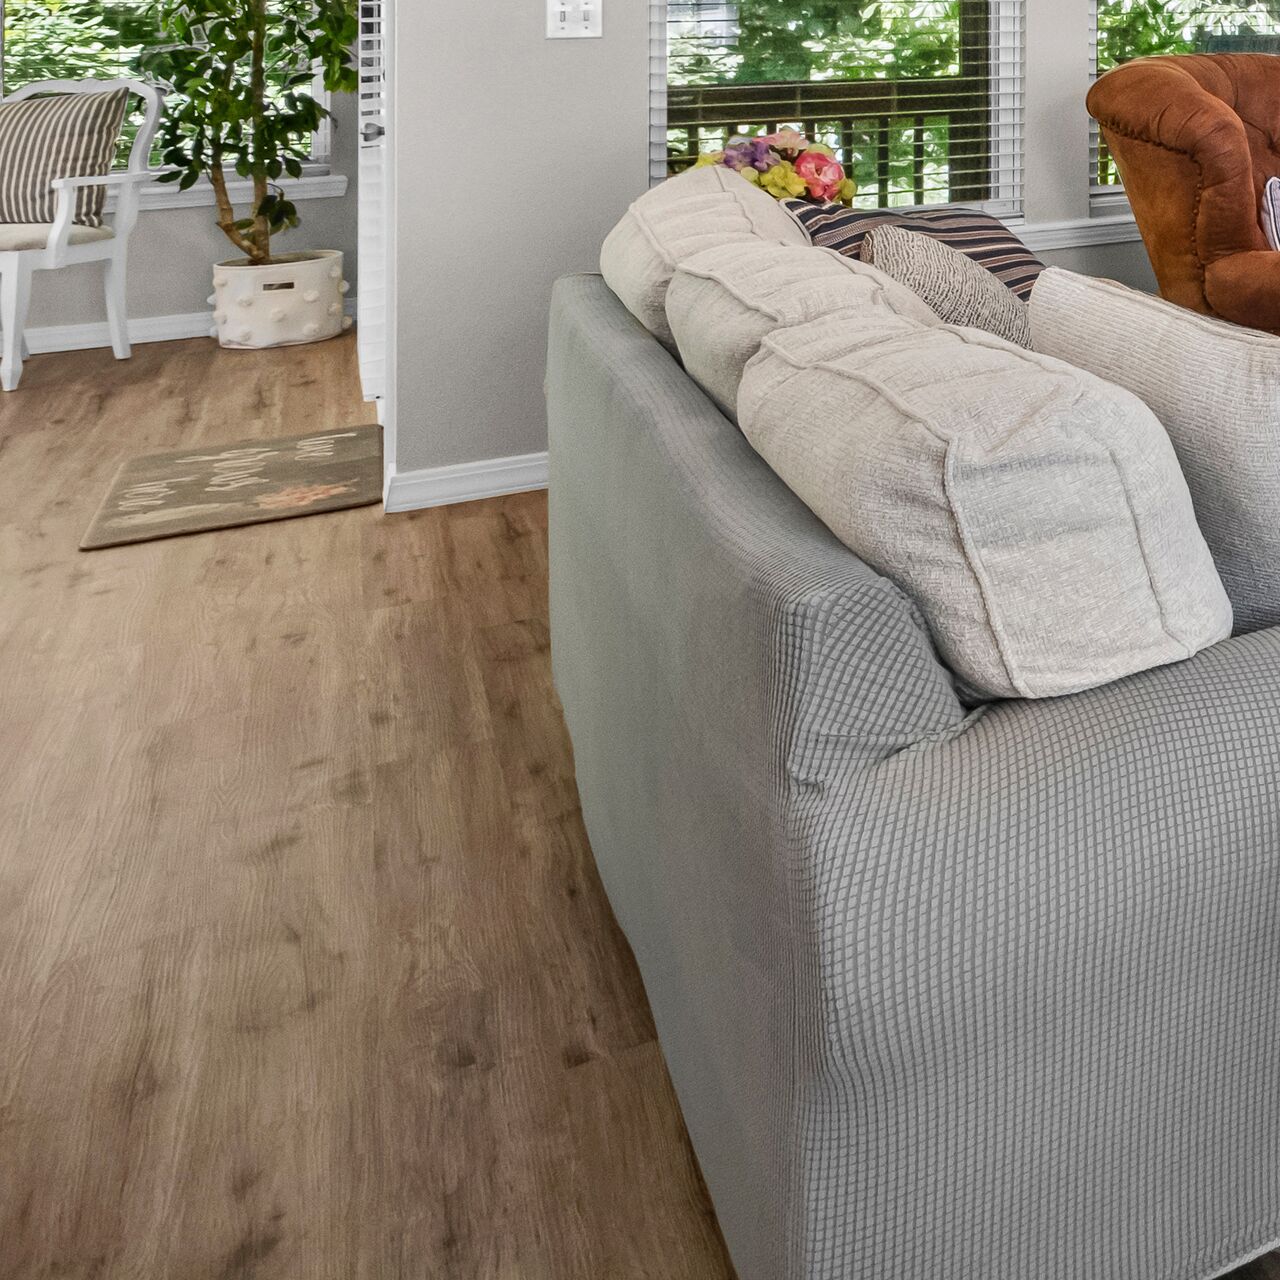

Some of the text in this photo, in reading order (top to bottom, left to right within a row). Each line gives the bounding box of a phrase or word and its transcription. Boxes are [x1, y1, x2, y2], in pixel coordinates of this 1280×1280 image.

[294, 431, 358, 462] love
[174, 447, 279, 492] grows
[116, 472, 201, 512] here
